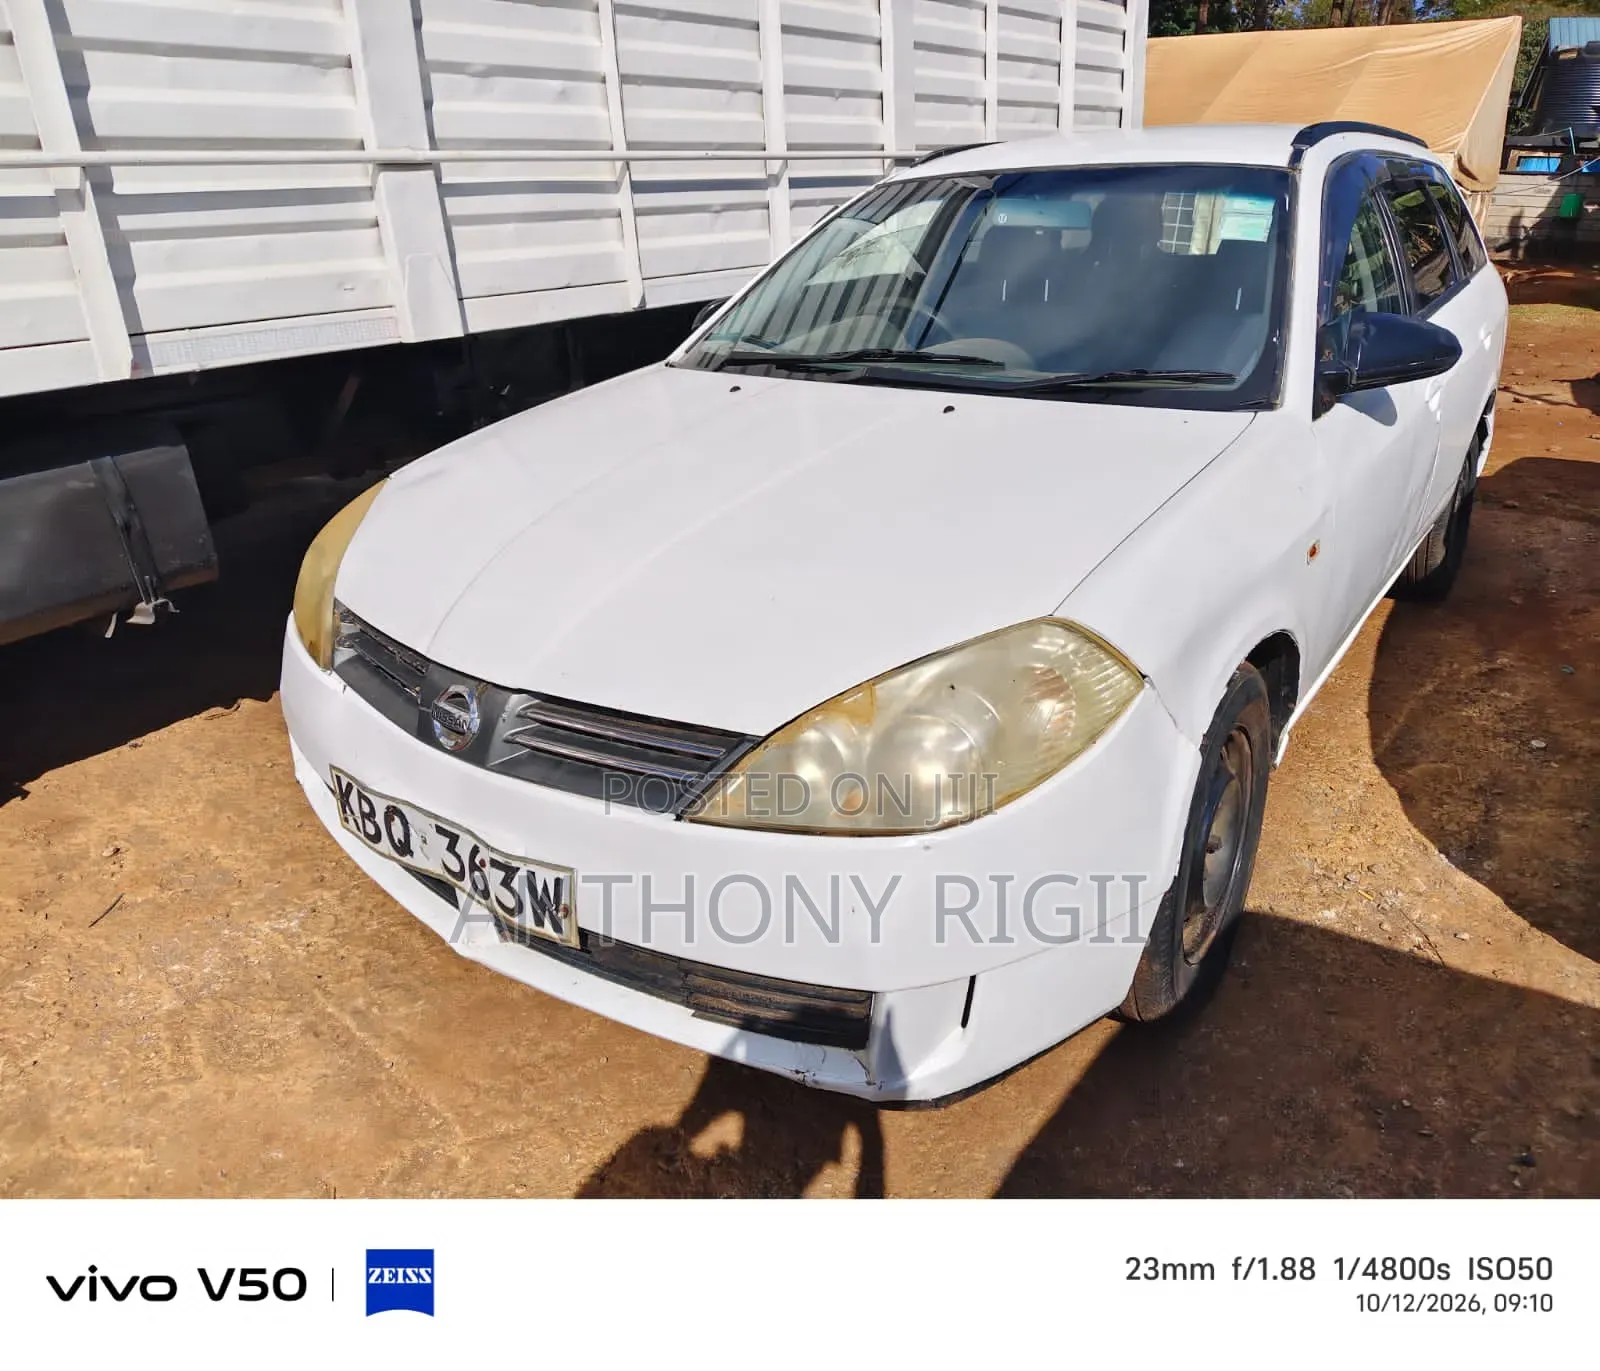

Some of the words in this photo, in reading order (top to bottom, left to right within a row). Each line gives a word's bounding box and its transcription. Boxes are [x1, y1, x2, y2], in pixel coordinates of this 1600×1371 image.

[432, 704, 473, 732] NISSAN
[335, 774, 415, 860] KBQ
[435, 823, 567, 934] 363W
